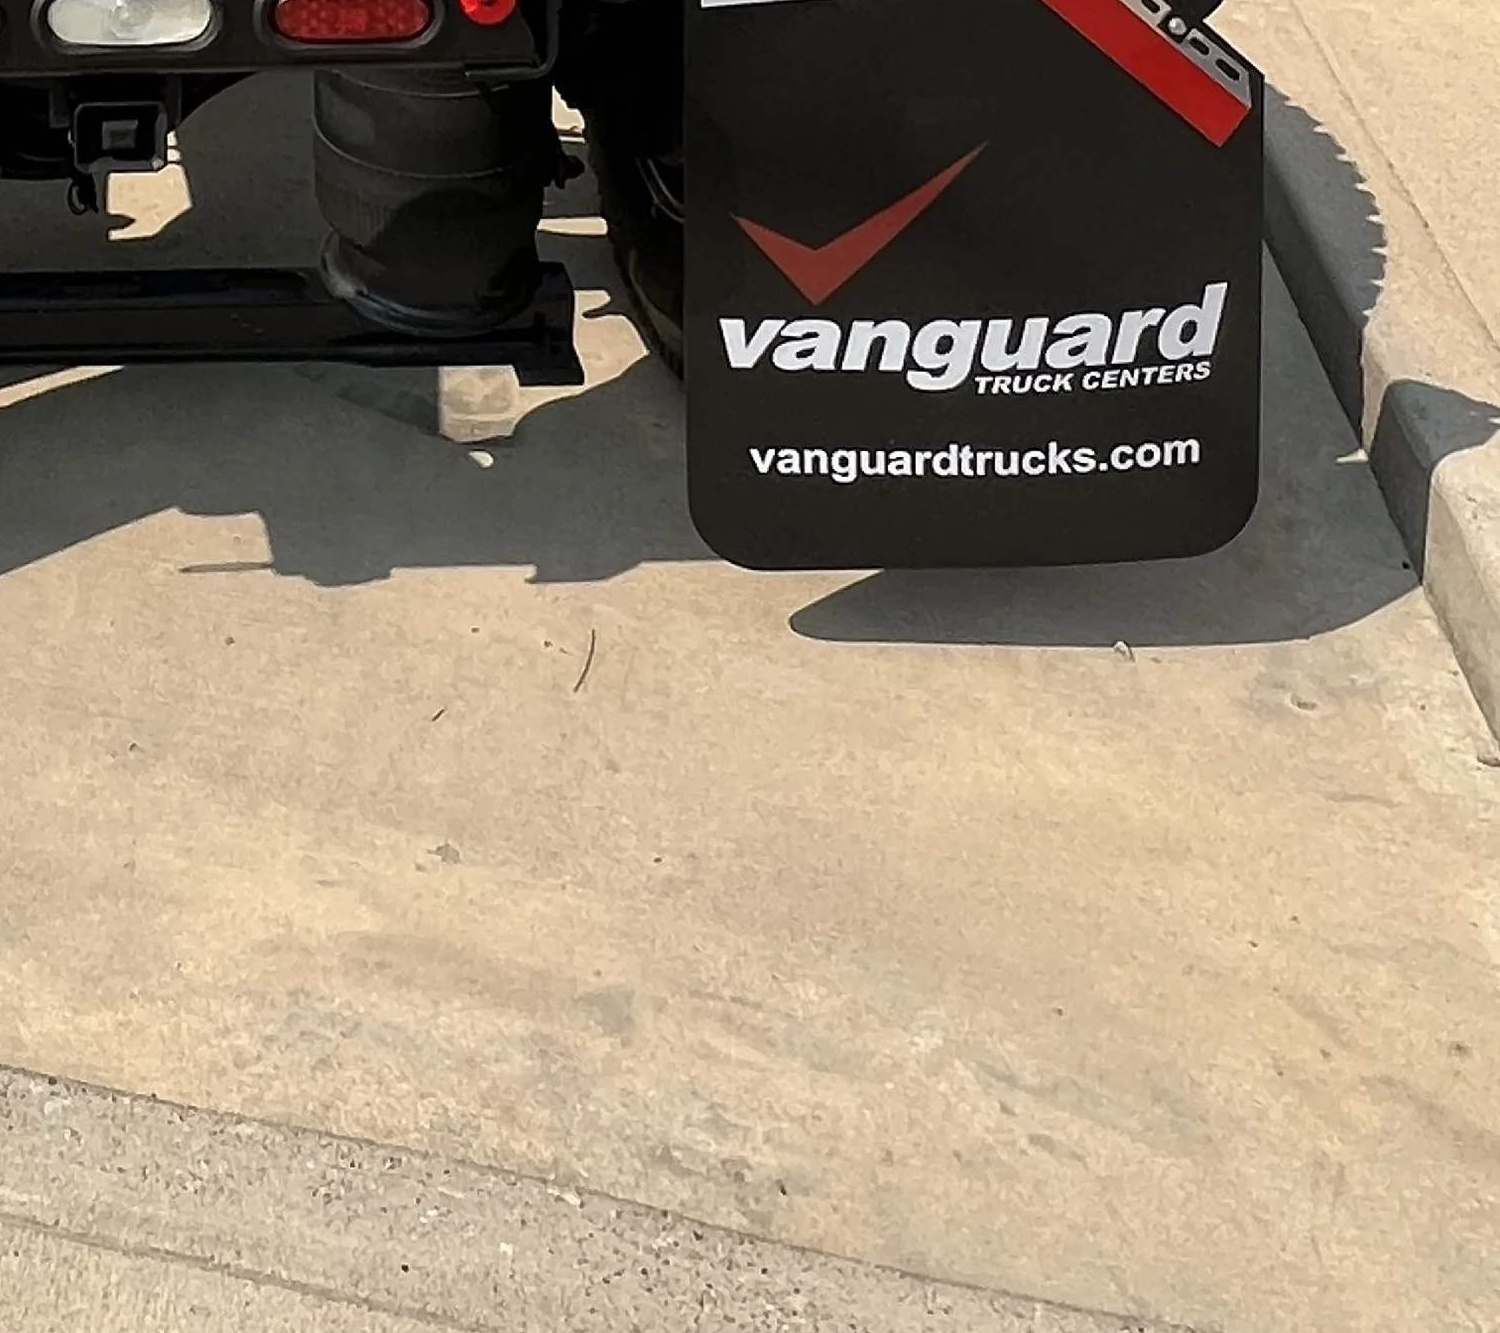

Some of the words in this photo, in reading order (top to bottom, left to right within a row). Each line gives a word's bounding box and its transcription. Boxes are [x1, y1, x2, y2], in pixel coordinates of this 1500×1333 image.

[719, 282, 1228, 391] vanguard
[975, 373, 1073, 395] TRUCK
[1082, 361, 1211, 390] CENTERS
[750, 437, 1200, 483] vanguardtrucks.com
